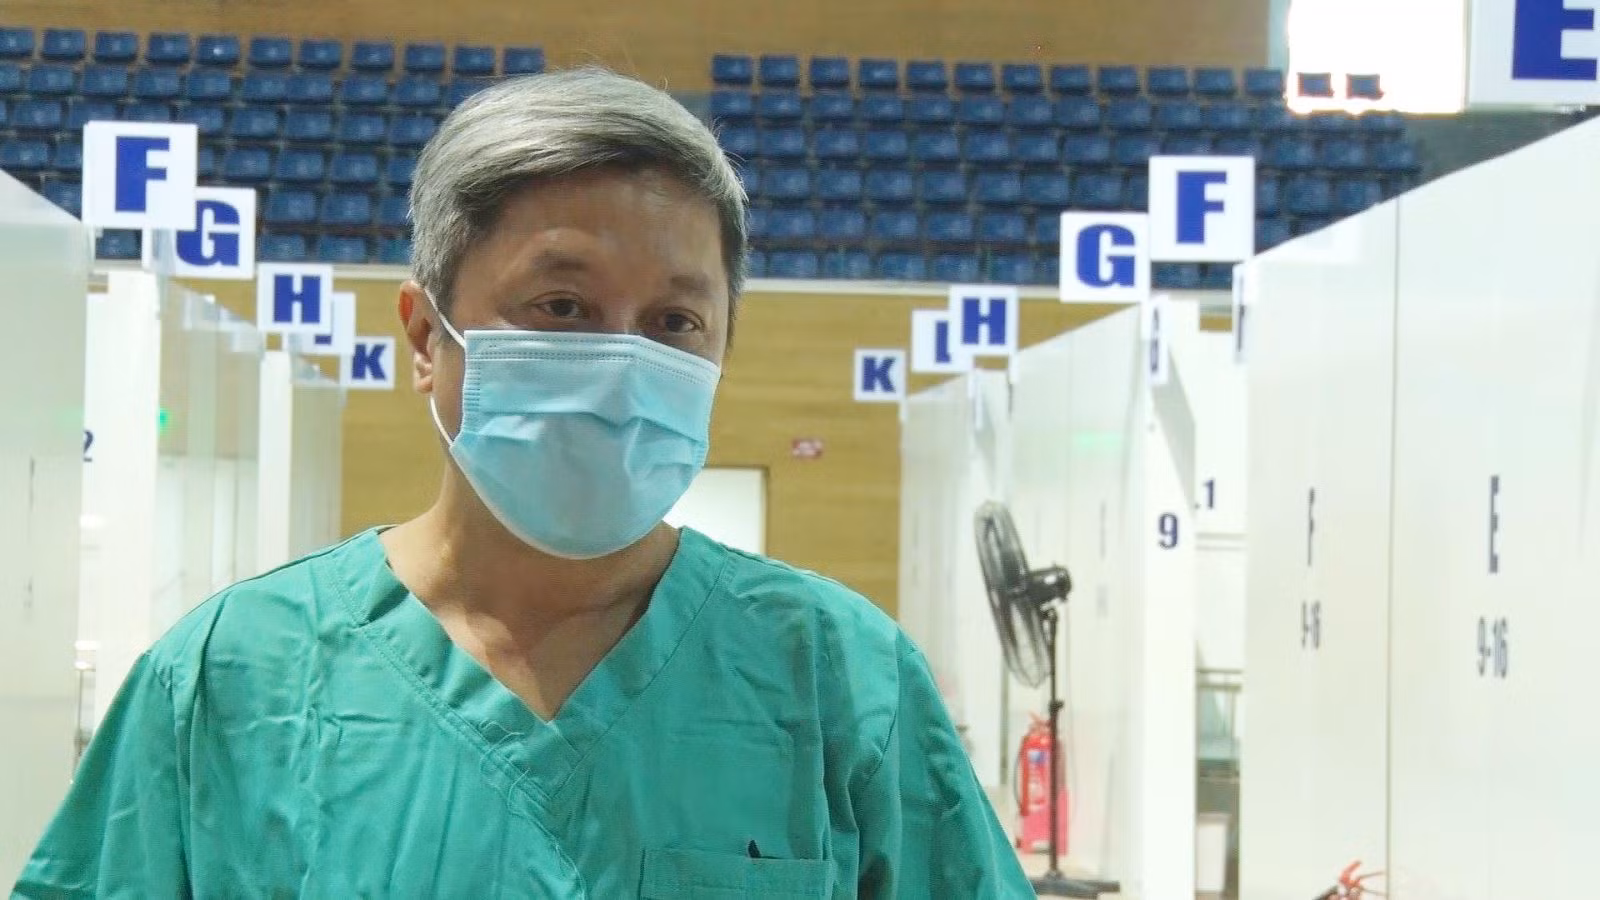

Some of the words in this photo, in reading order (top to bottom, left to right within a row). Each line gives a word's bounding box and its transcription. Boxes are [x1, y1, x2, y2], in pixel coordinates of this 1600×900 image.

[1512, 0, 1598, 80] E
[115, 136, 170, 212] F
[176, 200, 240, 266] G
[1176, 171, 1227, 244] F
[1076, 224, 1135, 288] G
[273, 274, 320, 324] H
[962, 298, 1007, 345] H
[352, 344, 386, 380] K
[862, 357, 896, 392] K
[1158, 513, 1178, 549] 9
[1308, 487, 1315, 565] F
[1489, 475, 1499, 573] E
[1478, 616, 1508, 677] 9-16
